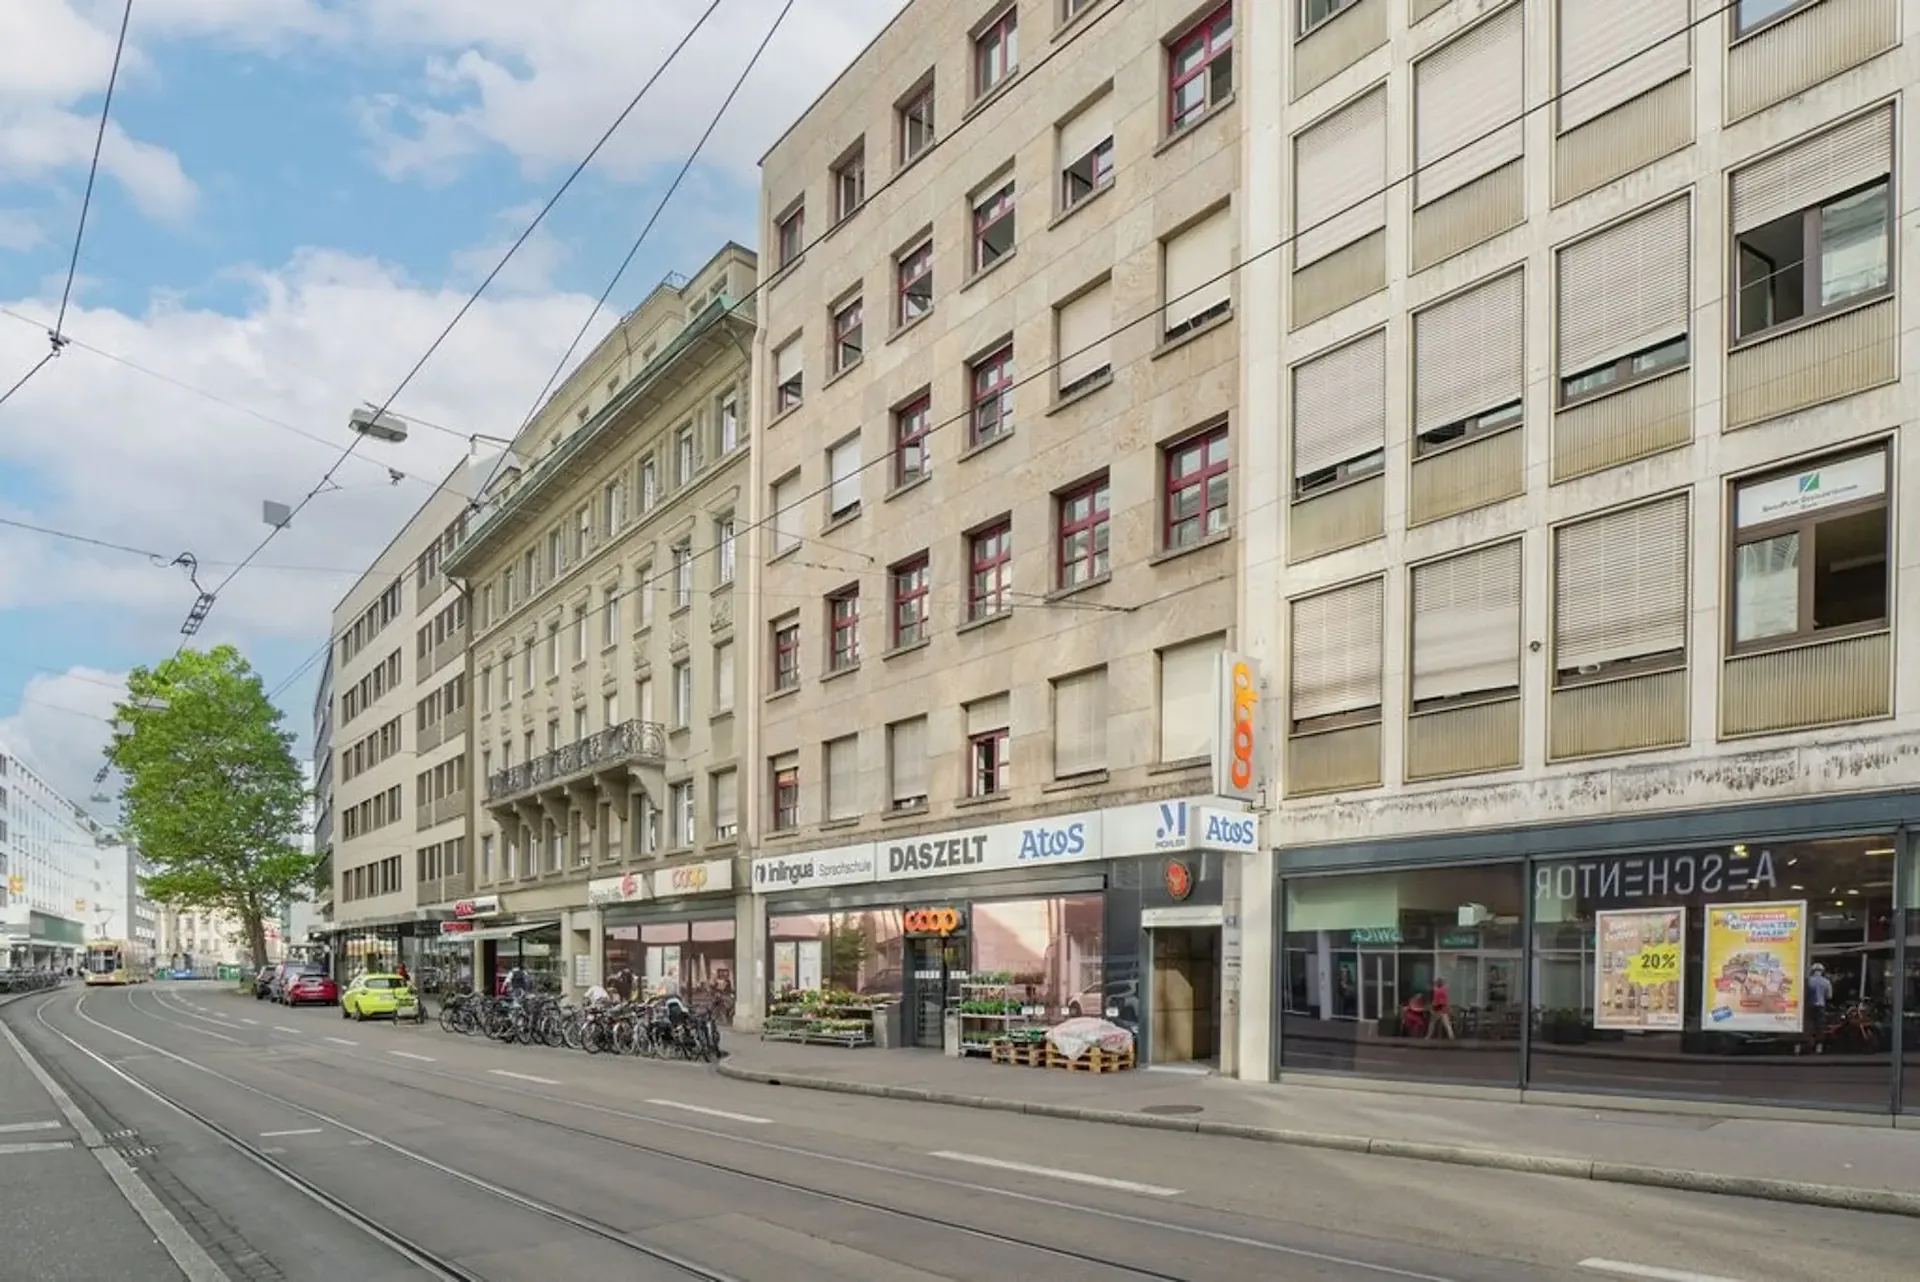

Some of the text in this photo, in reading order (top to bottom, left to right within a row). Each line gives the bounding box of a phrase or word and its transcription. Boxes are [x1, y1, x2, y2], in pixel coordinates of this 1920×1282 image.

[1232, 661, 1257, 789] coop
[889, 835, 987, 872] DASZELT
[768, 860, 814, 884] inlingua
[904, 907, 960, 937] coop
[1641, 953, 1676, 969] 20%
